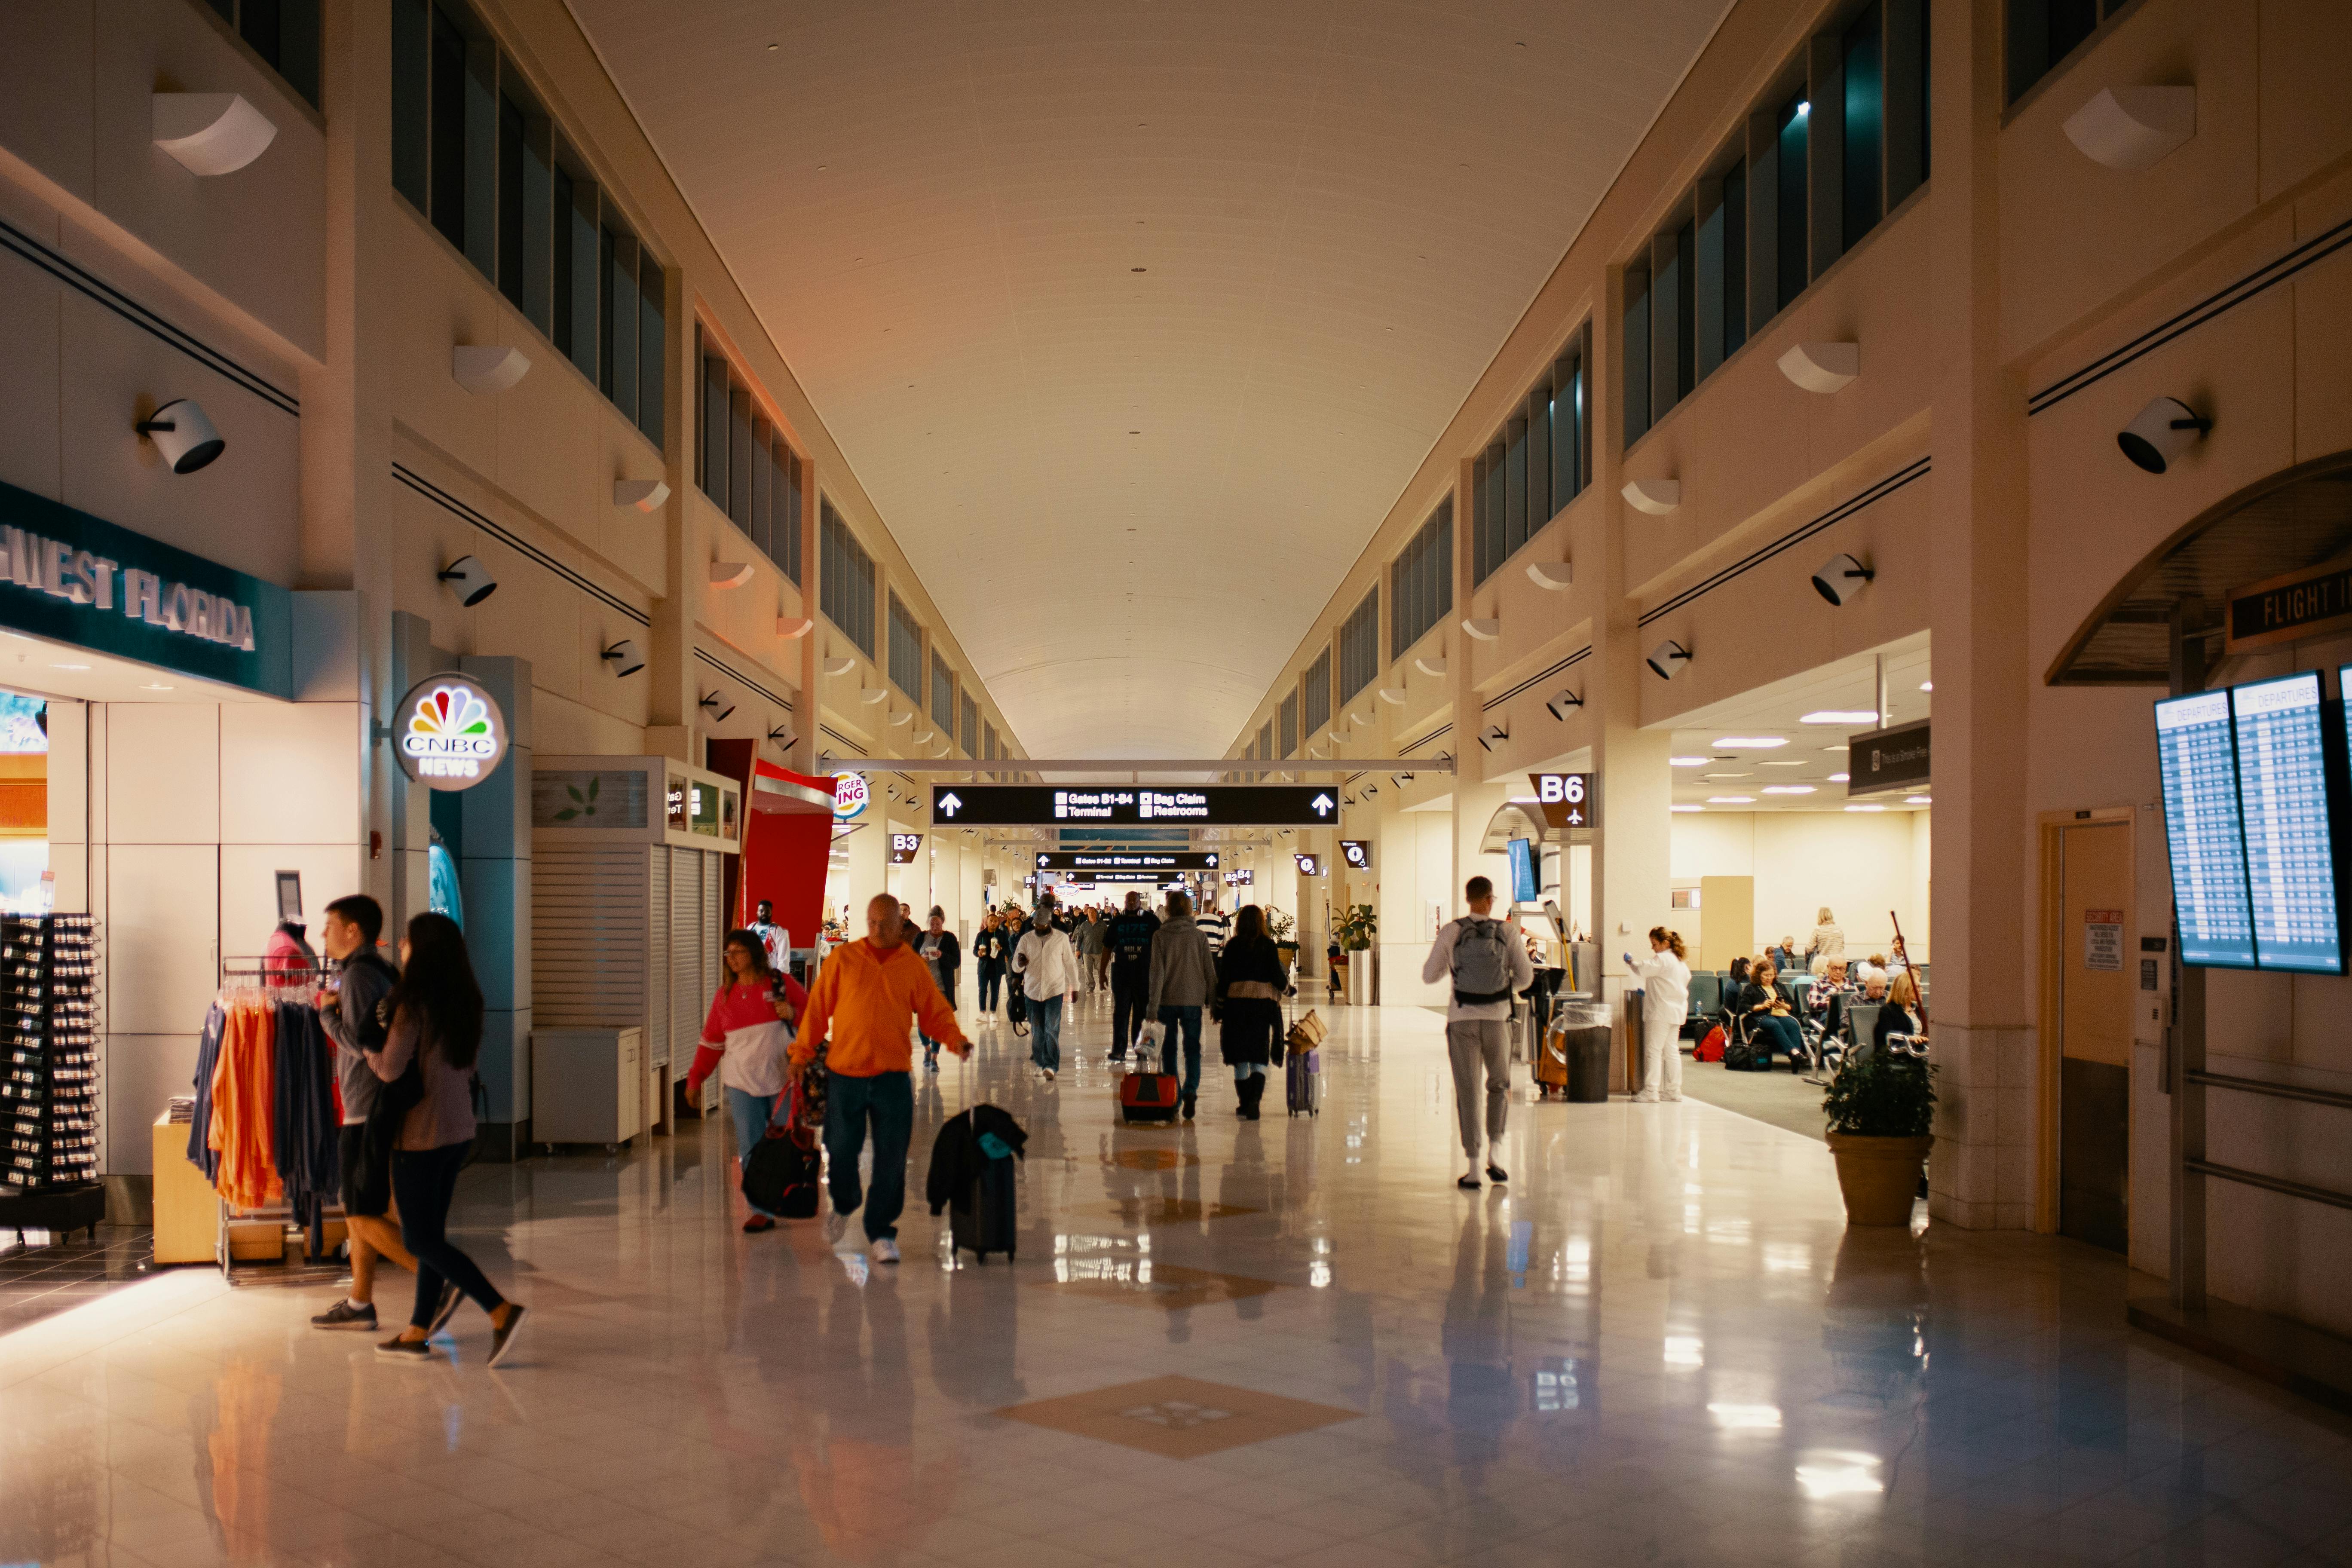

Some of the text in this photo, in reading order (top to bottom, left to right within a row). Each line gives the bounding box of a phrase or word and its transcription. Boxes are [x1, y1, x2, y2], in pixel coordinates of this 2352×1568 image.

[2264, 575, 2352, 626] FLIGHT I
[125, 568, 255, 651] FLORIDA
[2258, 685, 2318, 708] DEPARTURES
[2177, 701, 2228, 721] DEPARTURES
[407, 737, 491, 754] CNBC
[419, 758, 479, 777] NEWS
[838, 779, 862, 792] RGER
[1540, 775, 1584, 803] B6
[838, 787, 864, 805] ING
[1069, 793, 1133, 804] Gates B1-B4
[1154, 793, 1206, 806] Bag Claim
[1068, 806, 1112, 817] Terminal
[1154, 806, 1208, 816] Restrooms
[893, 835, 917, 851] B3
[1225, 873, 1237, 882] B2
[1237, 870, 1250, 879] B4
